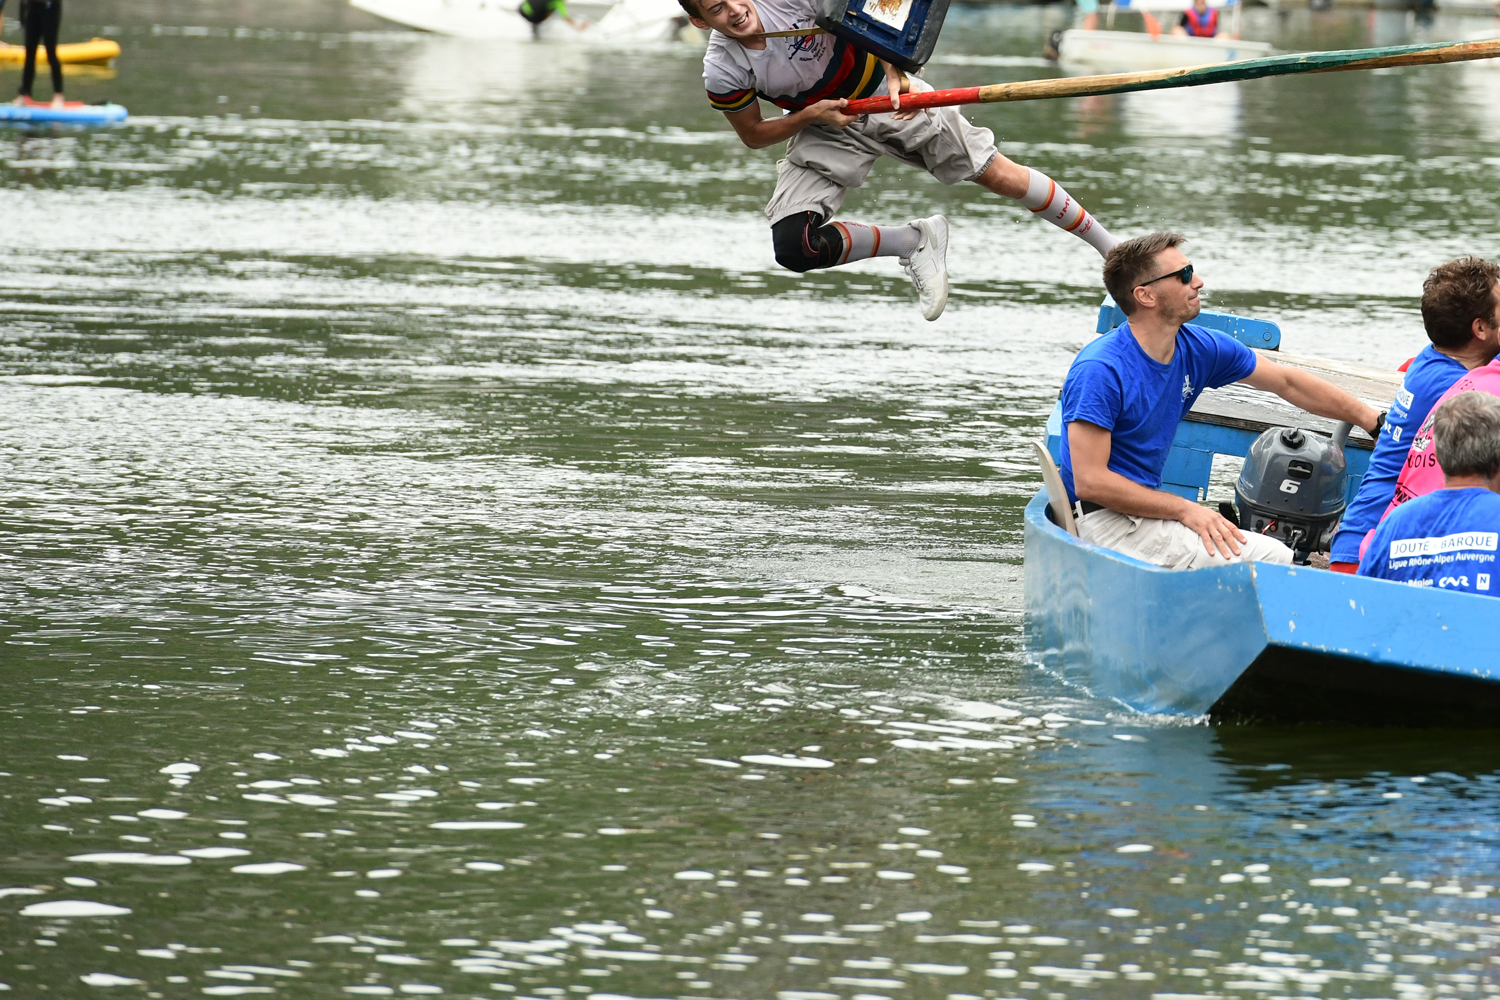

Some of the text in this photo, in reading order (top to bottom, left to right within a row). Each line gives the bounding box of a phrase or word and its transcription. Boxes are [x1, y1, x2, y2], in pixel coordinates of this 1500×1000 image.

[1279, 479, 1301, 494] 6
[1394, 540, 1430, 555] JOUTE
[1441, 535, 1493, 549] BARQUE
[1389, 551, 1496, 570] Ligue Rhône-Alpes Auvergne
